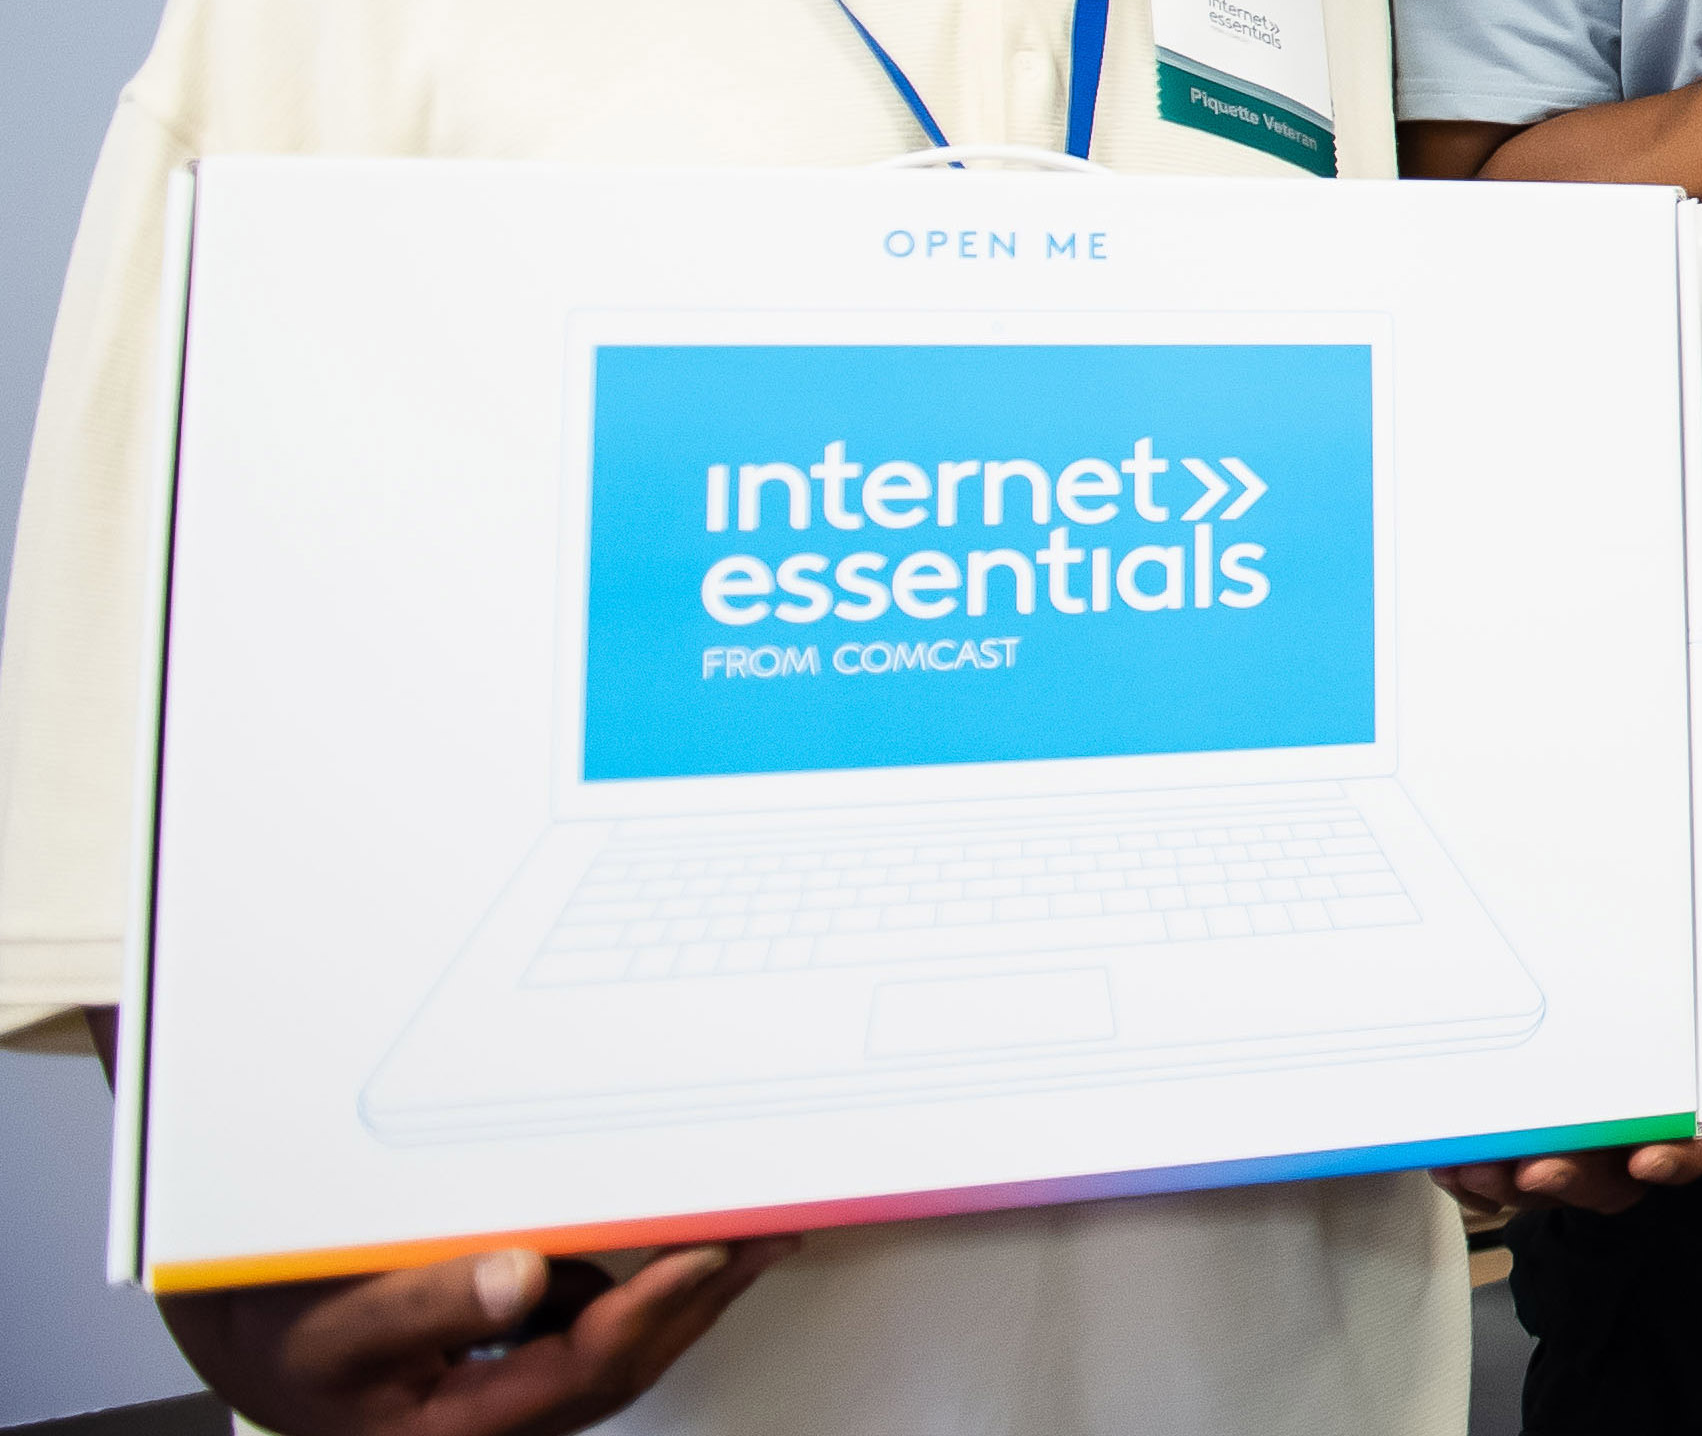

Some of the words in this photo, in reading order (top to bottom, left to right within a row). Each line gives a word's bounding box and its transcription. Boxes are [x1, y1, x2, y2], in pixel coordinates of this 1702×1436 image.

[1208, 10, 1282, 50] essentials
[1189, 86, 1259, 126] Piquette
[1262, 113, 1318, 152] Veteran
[883, 228, 1019, 259] OPEN
[1045, 231, 1109, 260] ME
[704, 435, 1170, 533] internet
[700, 521, 1271, 627] essentials
[701, 644, 820, 680] FROM
[832, 636, 1021, 675] COMCAST
